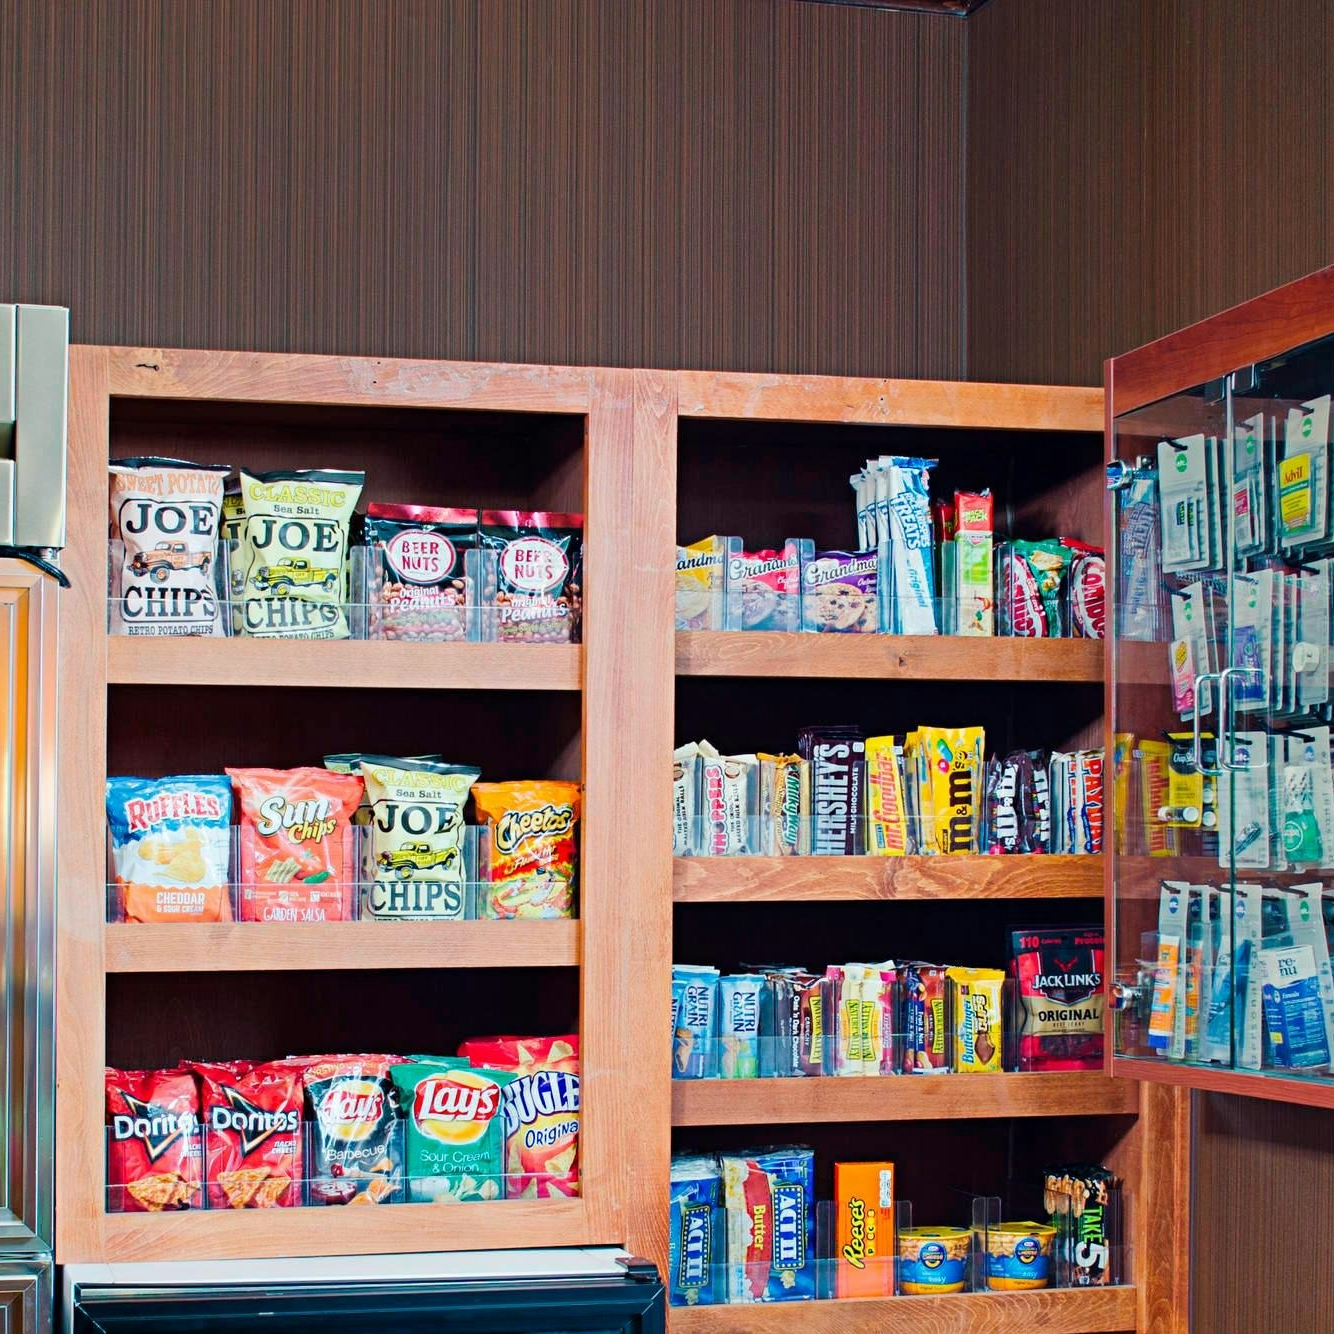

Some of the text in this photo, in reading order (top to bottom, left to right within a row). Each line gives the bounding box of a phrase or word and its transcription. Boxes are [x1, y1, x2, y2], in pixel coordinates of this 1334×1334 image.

[117, 472, 163, 496] SWEET
[1283, 465, 1304, 484] Advil
[249, 483, 347, 507] CLASSIC
[273, 504, 320, 516] Sea Salt
[126, 502, 214, 535] JOE
[252, 519, 339, 552] JOE
[402, 540, 440, 555] BEER
[402, 557, 440, 573] NUTS
[515, 549, 552, 562] BEER
[515, 565, 554, 580] NUTS
[123, 586, 216, 618] CHIPS
[390, 594, 456, 613] Peanuts
[399, 586, 440, 598] Original
[245, 597, 339, 630] CHIPS
[501, 603, 566, 623] Peanuts
[128, 624, 214, 636] RETRO POTATO CHIPS
[371, 769, 467, 792] CLASSIC
[396, 789, 443, 800] Sea Salt
[850, 767, 858, 814] CHOCOLATE
[126, 792, 221, 832] RUFFLES
[705, 766, 727, 855] WHOPPERS
[817, 743, 850, 855] HERSHEY'S
[257, 796, 331, 837] Sun
[377, 804, 459, 836] JOE
[495, 804, 575, 855] Cheetos
[156, 892, 205, 905] CHEDDAR
[369, 880, 462, 912] CHIPS
[263, 906, 326, 922] GARDEN SALSA
[1019, 936, 1039, 948] 110
[1033, 973, 1101, 990] JACK LINK'S
[1279, 966, 1297, 977] nu
[686, 986, 699, 1026] GRAIN
[696, 987, 709, 1027] NUTRI
[733, 991, 745, 1032] GRAIN
[744, 992, 756, 1032] NUTRI
[1038, 1008, 1100, 1022] ORIGINAL
[961, 1000, 976, 1064] Butterfinger
[792, 1036, 801, 1068] Chocolate
[418, 1080, 499, 1121] Lay's
[113, 1110, 199, 1140] Doritos
[212, 1107, 298, 1132] Doritos
[326, 1144, 387, 1162] Barbecue
[420, 1149, 490, 1163] Sour Cream
[432, 1163, 480, 1173] & Onion
[753, 1204, 767, 1250] Butter
[780, 1194, 797, 1261] ACT II
[842, 1196, 866, 1270] Reese's
[1074, 1205, 1108, 1270] TAKE 5
[686, 1216, 705, 1279] ACT II
